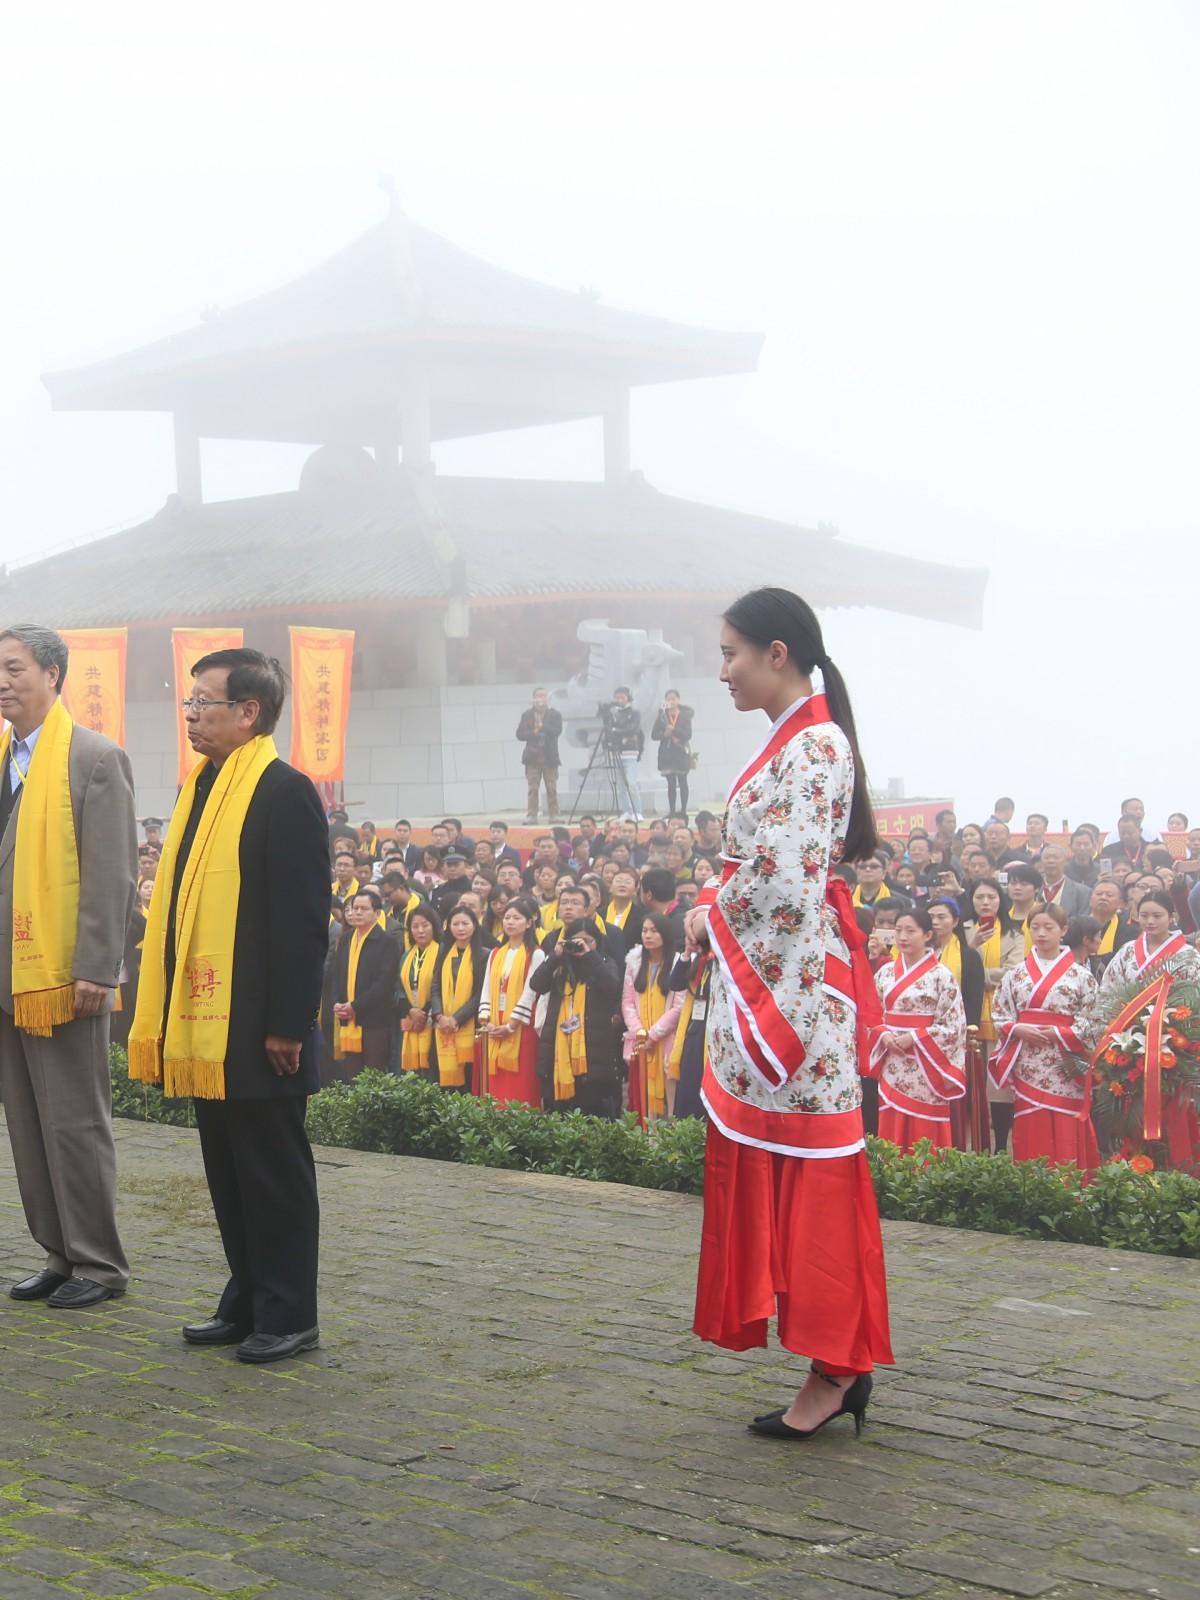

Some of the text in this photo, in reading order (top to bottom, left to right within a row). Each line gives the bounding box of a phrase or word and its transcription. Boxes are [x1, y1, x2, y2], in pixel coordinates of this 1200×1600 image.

[314, 664, 331, 761] 共建精神家园
